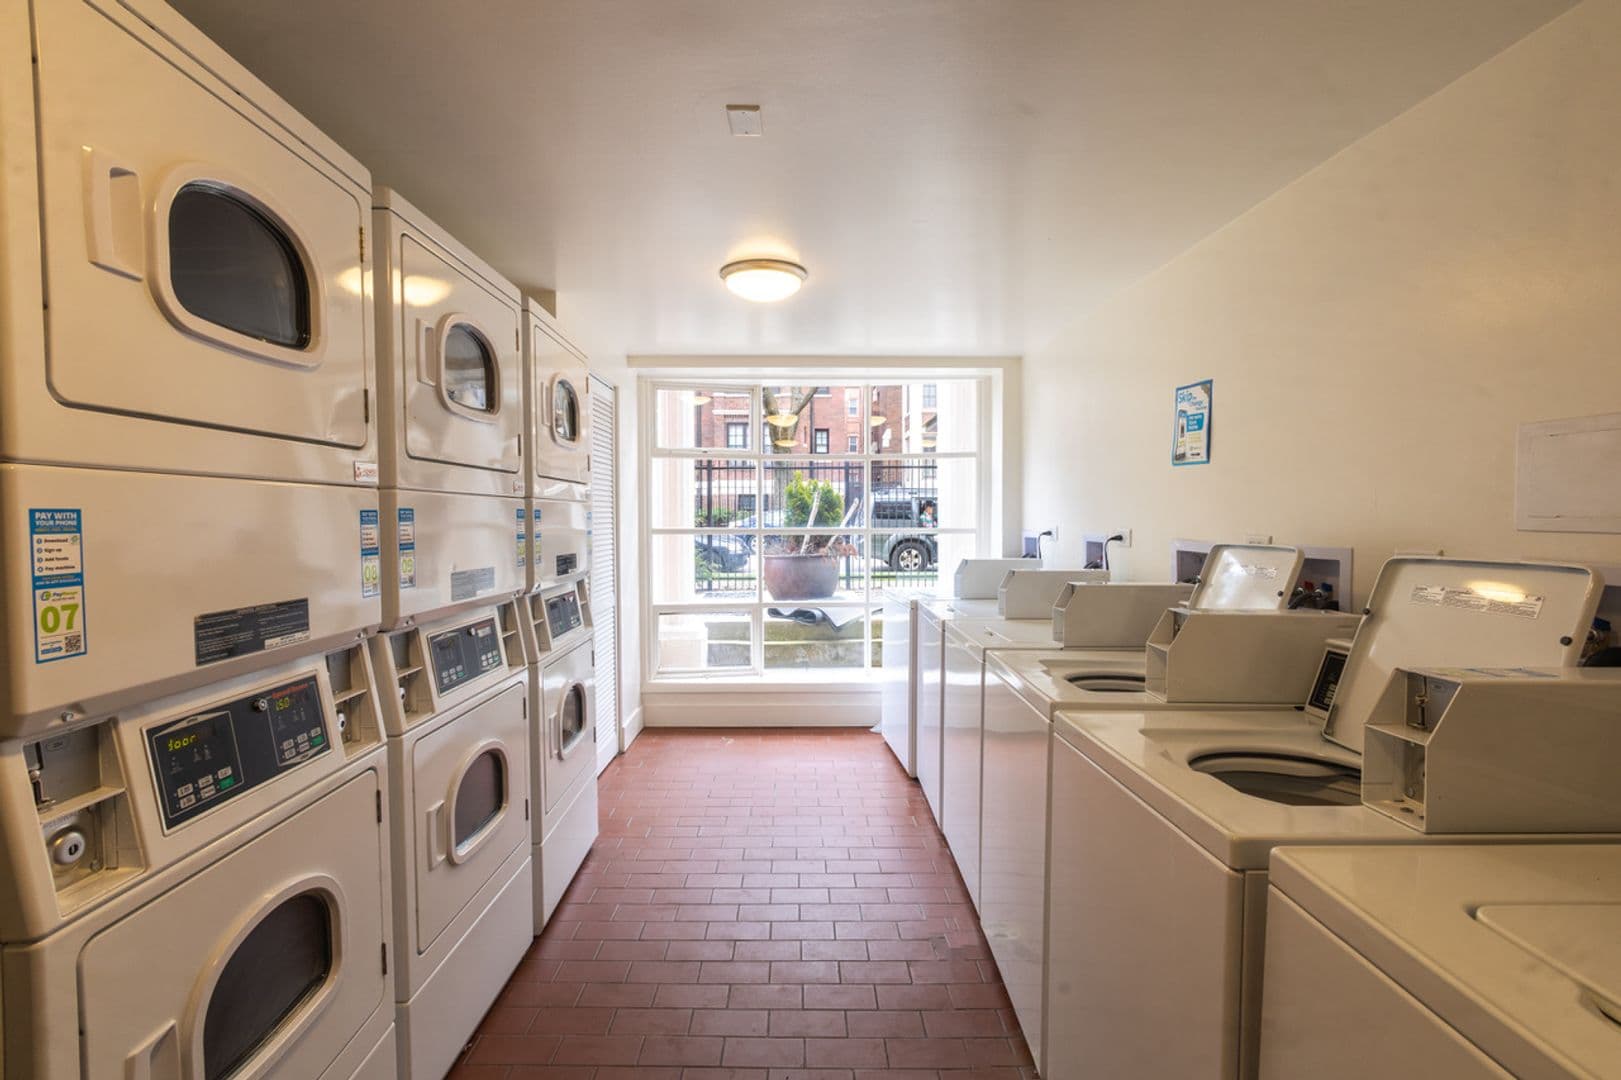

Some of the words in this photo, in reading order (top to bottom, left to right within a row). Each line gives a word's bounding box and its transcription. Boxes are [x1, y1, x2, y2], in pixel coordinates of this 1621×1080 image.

[35, 512, 52, 520] PAY
[54, 512, 77, 520] WITH
[364, 564, 377, 581] 08
[40, 603, 79, 634] 07
